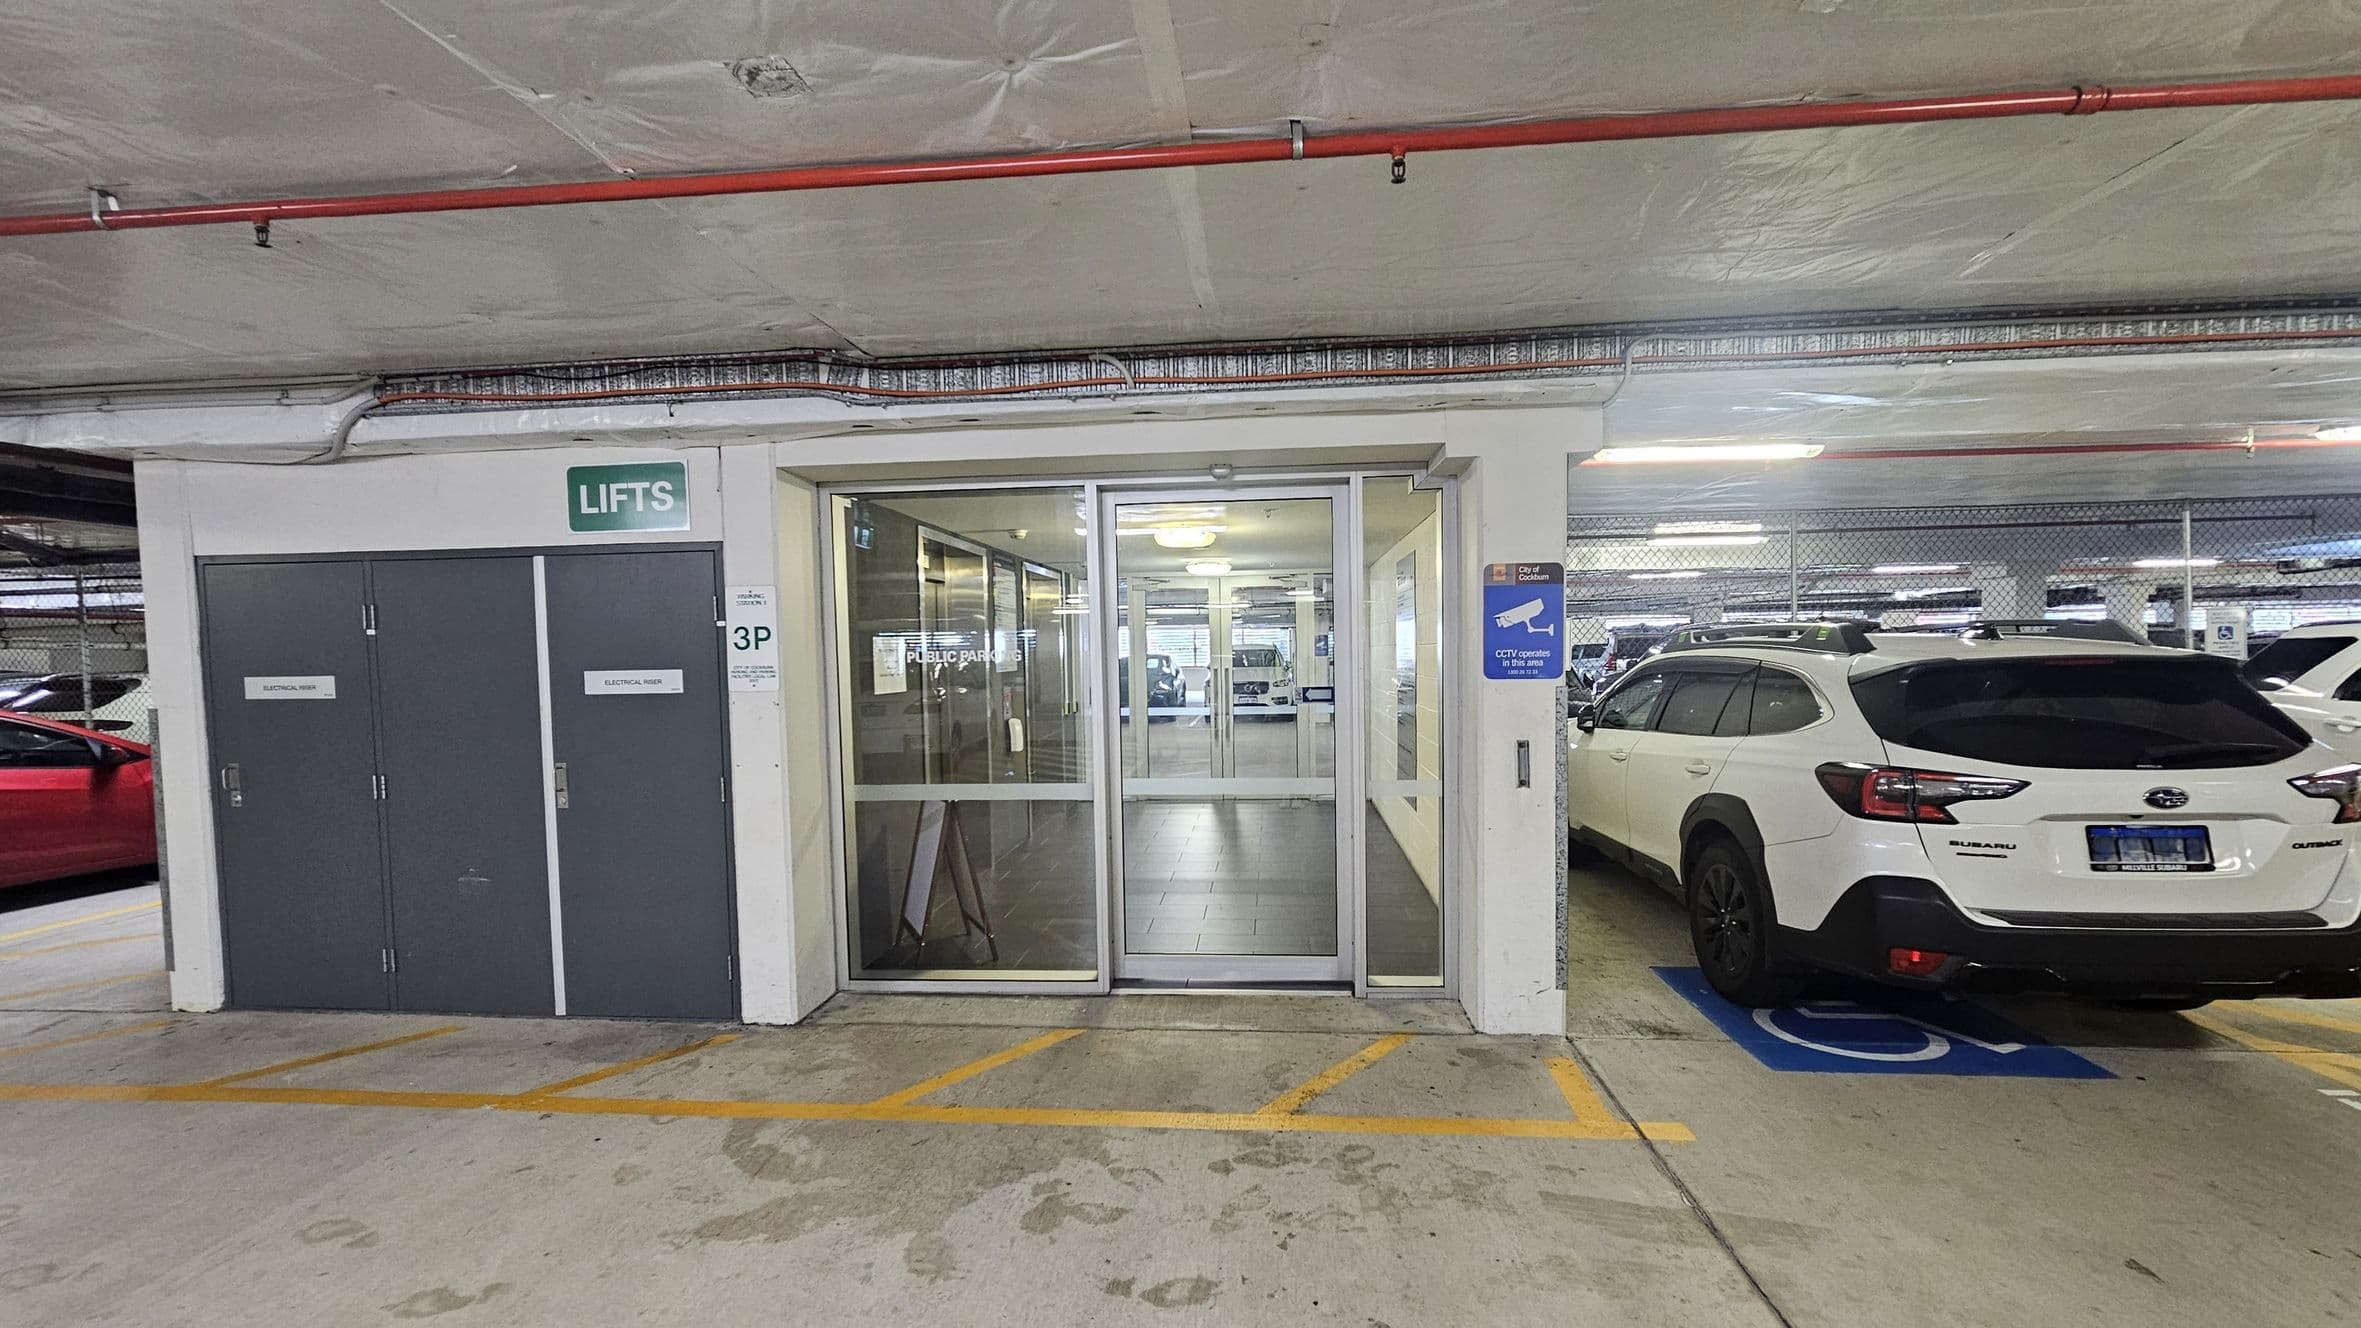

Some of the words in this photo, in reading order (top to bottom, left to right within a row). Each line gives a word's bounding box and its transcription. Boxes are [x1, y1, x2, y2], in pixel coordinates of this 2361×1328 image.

[579, 480, 674, 515] LIFTS
[1532, 565, 1540, 573] of
[1518, 573, 1550, 581] Cockburn
[733, 626, 771, 650] 3P
[906, 650, 957, 664] PUBLIC
[1495, 649, 1518, 658] CCTV
[1518, 649, 1551, 659] operates
[1503, 658, 1510, 667] in
[1511, 658, 1526, 667] this
[1948, 839, 2017, 850] SUBARU
